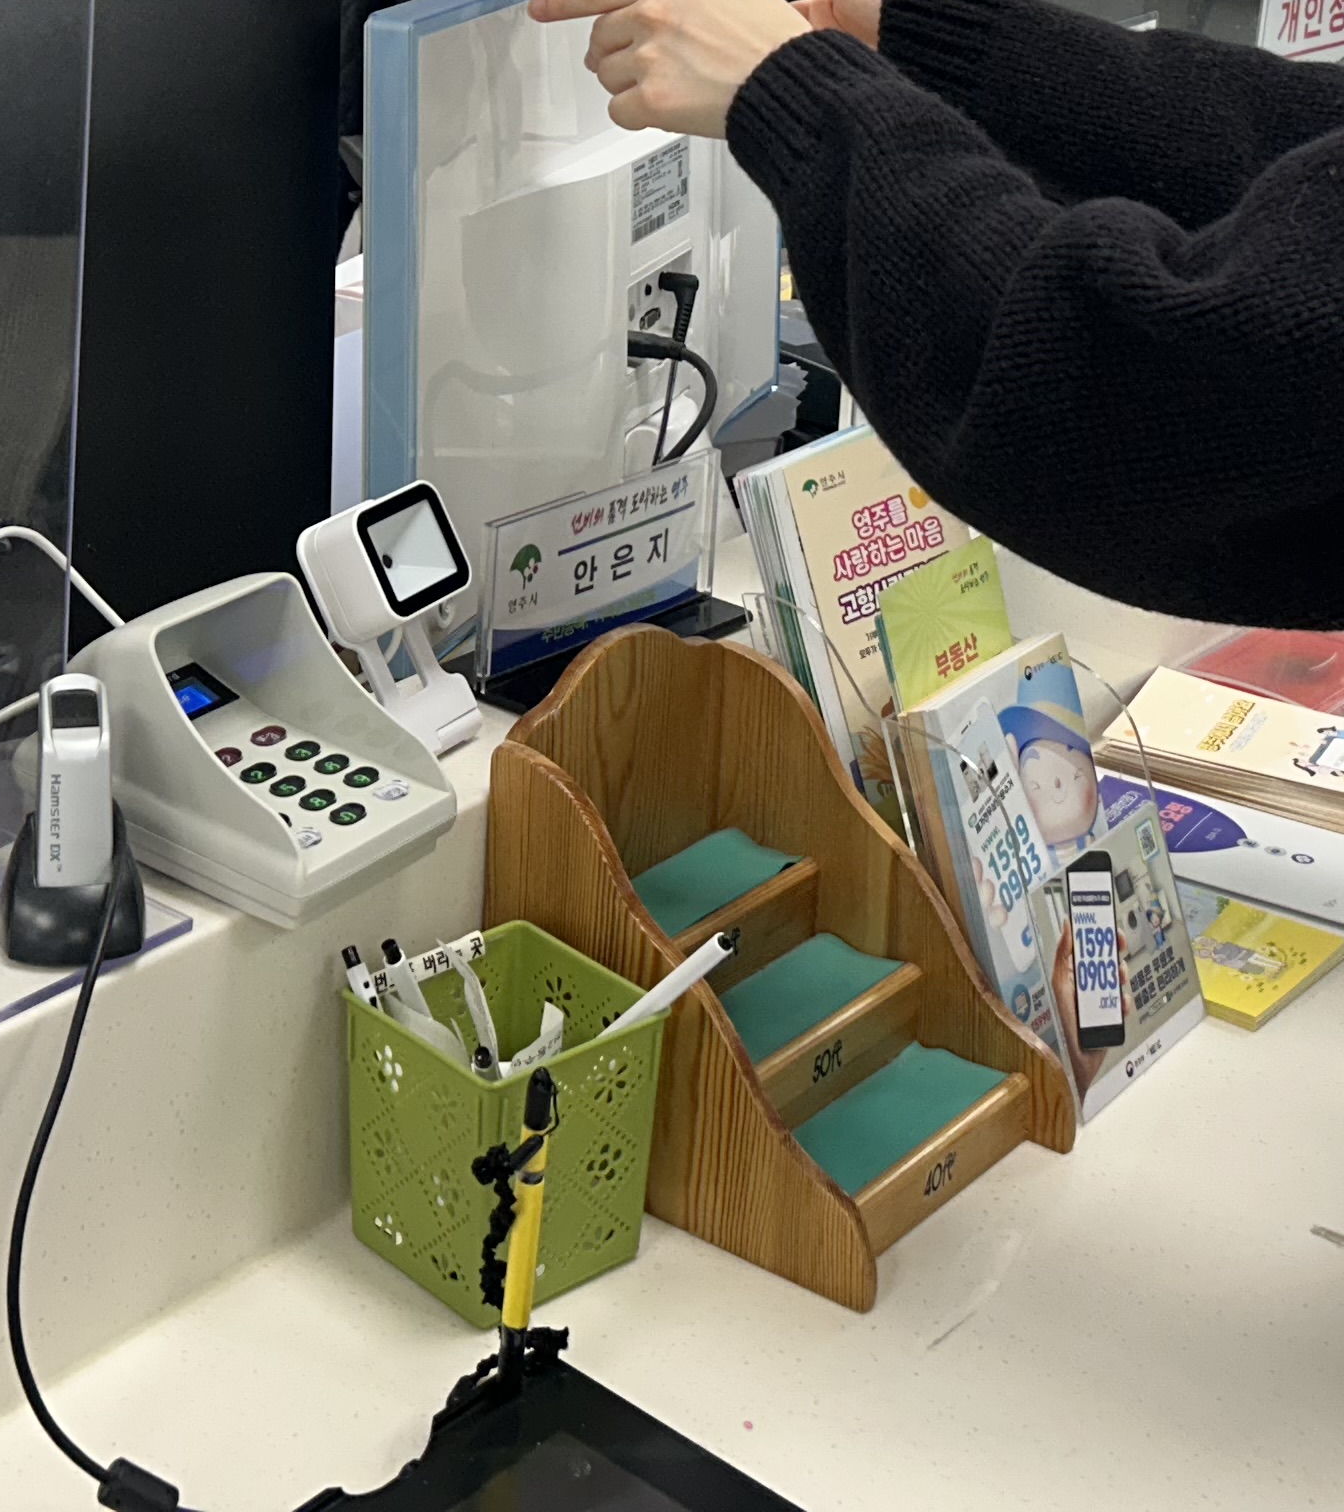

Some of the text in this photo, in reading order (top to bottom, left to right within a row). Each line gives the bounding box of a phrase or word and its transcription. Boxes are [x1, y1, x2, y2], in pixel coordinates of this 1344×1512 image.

[852, 494, 908, 539] 영주를
[834, 516, 945, 581] 사랑하는 마음
[507, 591, 538, 615] 영주시
[935, 633, 980, 678] 부동산
[279, 783, 297, 794] 5
[309, 773, 371, 808] 8 9
[49, 774, 62, 862] Hamster DX
[988, 814, 1030, 881] 1599
[998, 842, 1042, 913] 0903
[469, 936, 483, 960] 곳
[1075, 926, 1115, 959] 1599
[1077, 959, 1118, 992] 0903
